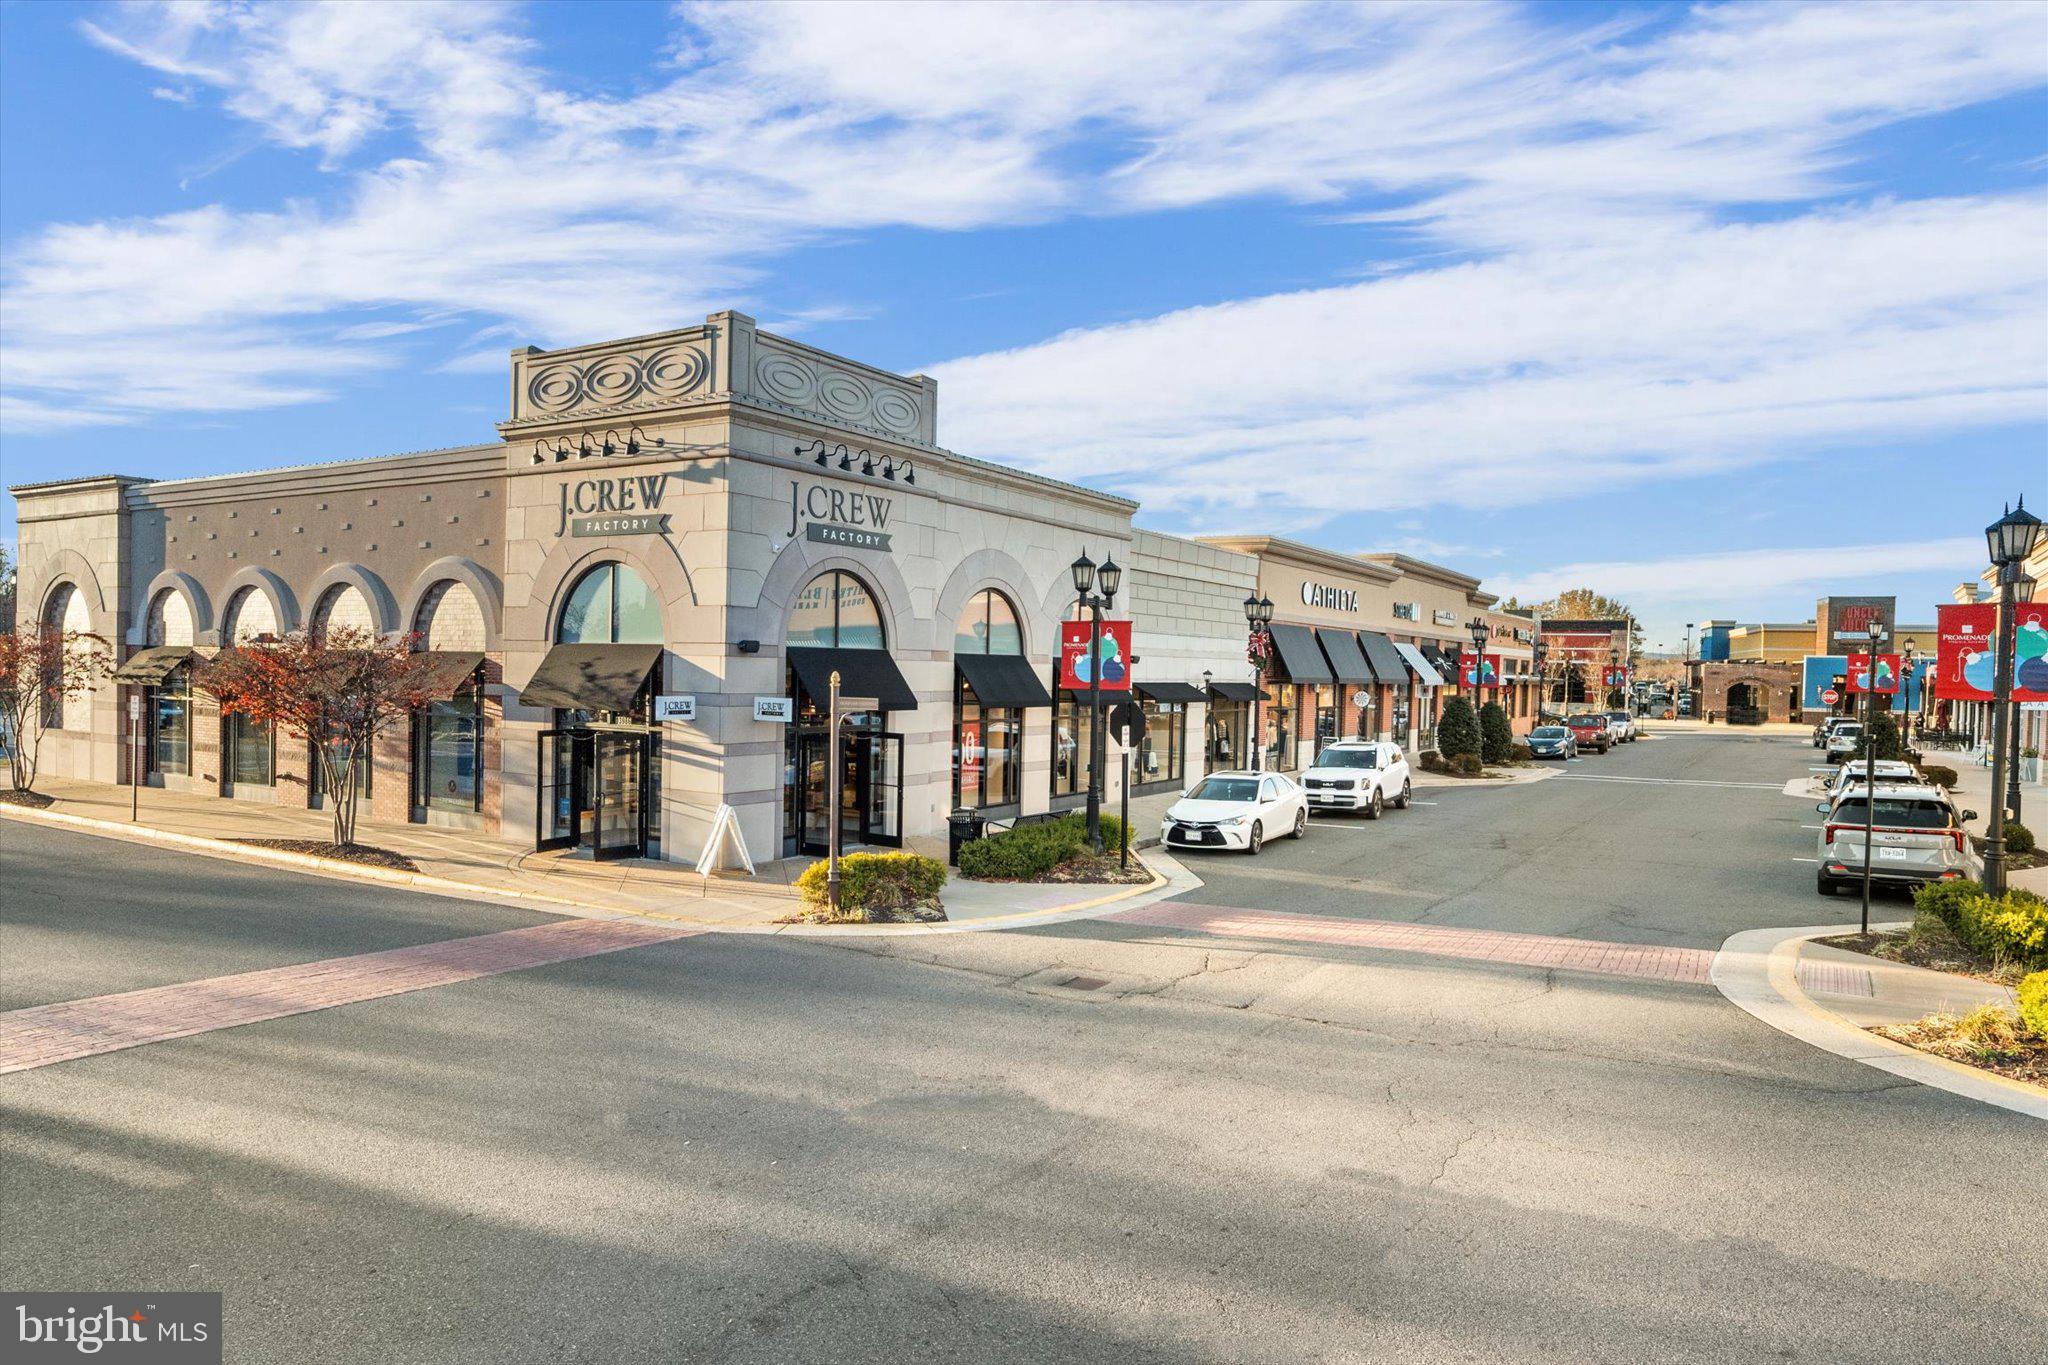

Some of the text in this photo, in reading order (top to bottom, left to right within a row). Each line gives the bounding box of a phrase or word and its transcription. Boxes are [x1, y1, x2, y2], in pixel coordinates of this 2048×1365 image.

[554, 474, 669, 538] J.CREW
[787, 481, 893, 538] J.CREW
[586, 518, 649, 532] FACTORY
[822, 529, 880, 546] FACTORY
[663, 701, 692, 715] J.CREW
